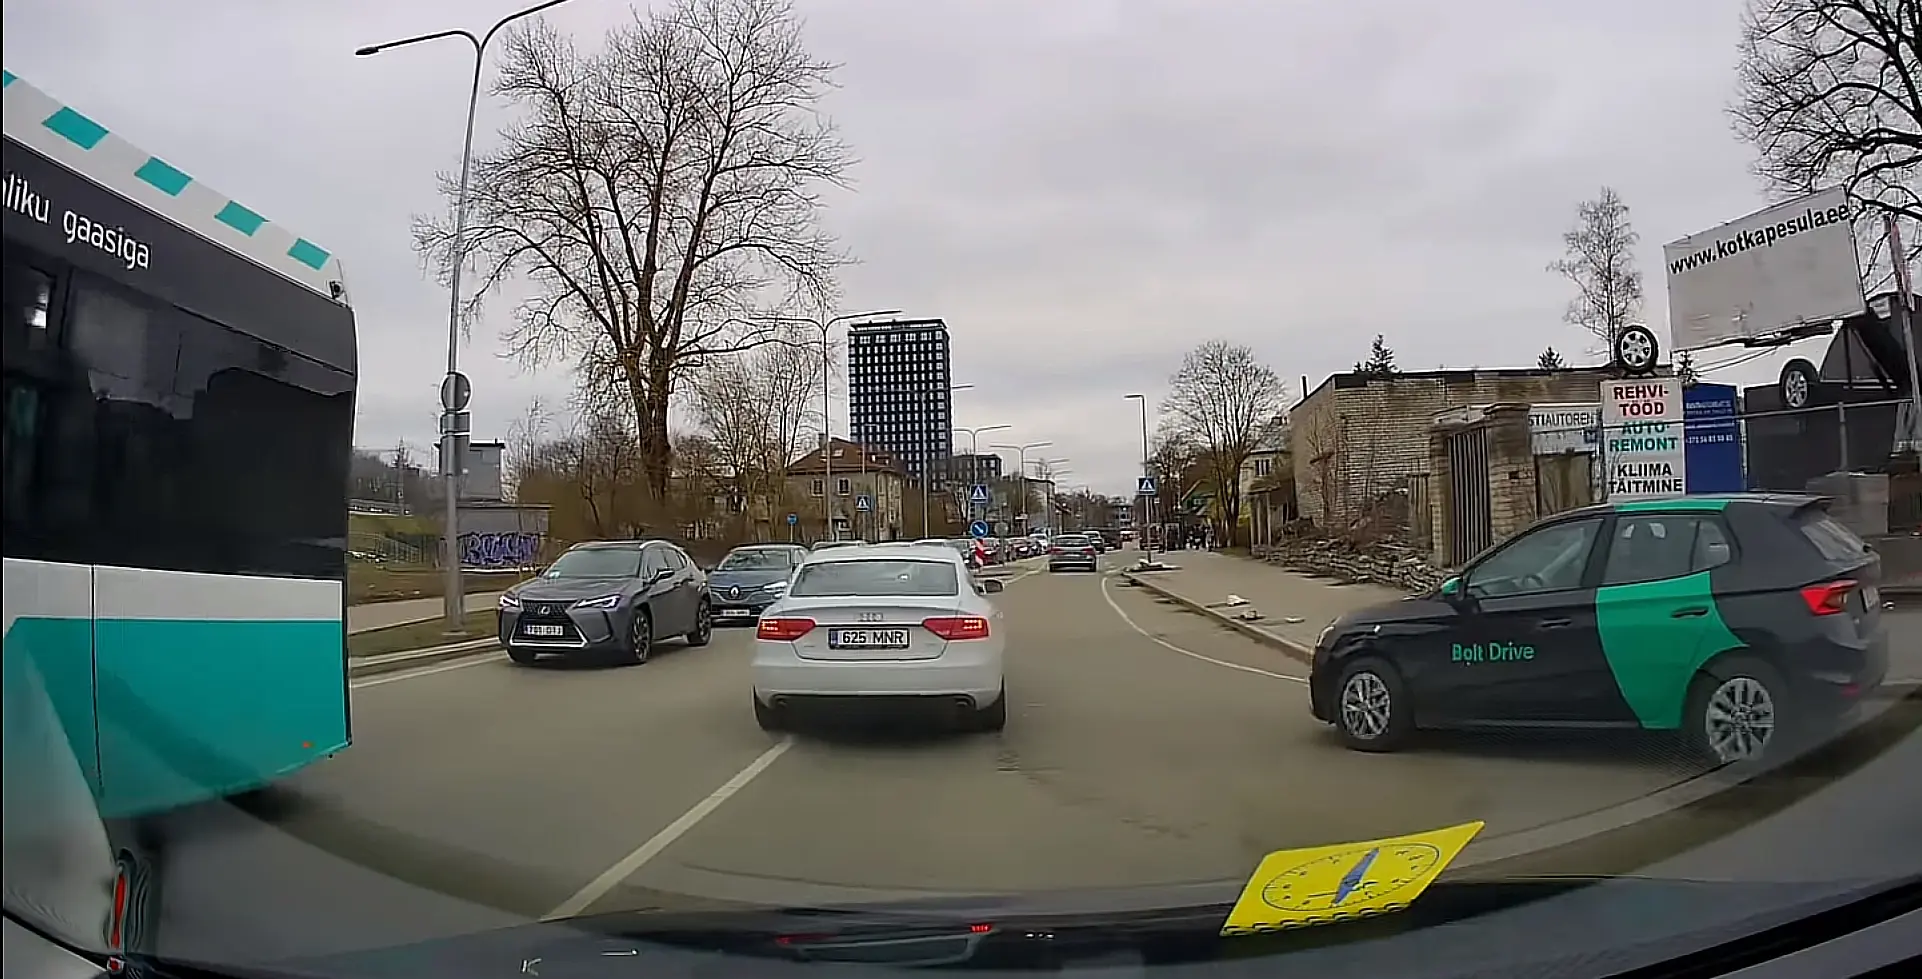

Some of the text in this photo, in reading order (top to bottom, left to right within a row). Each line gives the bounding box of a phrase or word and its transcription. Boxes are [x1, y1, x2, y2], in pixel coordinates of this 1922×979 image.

[63, 210, 150, 270] gaasiga
[1613, 384, 1669, 400] REHVI-
[1618, 399, 1664, 416] TÖÖD
[1609, 437, 1678, 452] REMONT
[1617, 463, 1672, 477] KLIIMA
[1608, 478, 1683, 494] TÄITMINE
[842, 631, 904, 644] 625 MNR
[1451, 641, 1535, 661] Bolt Drive
